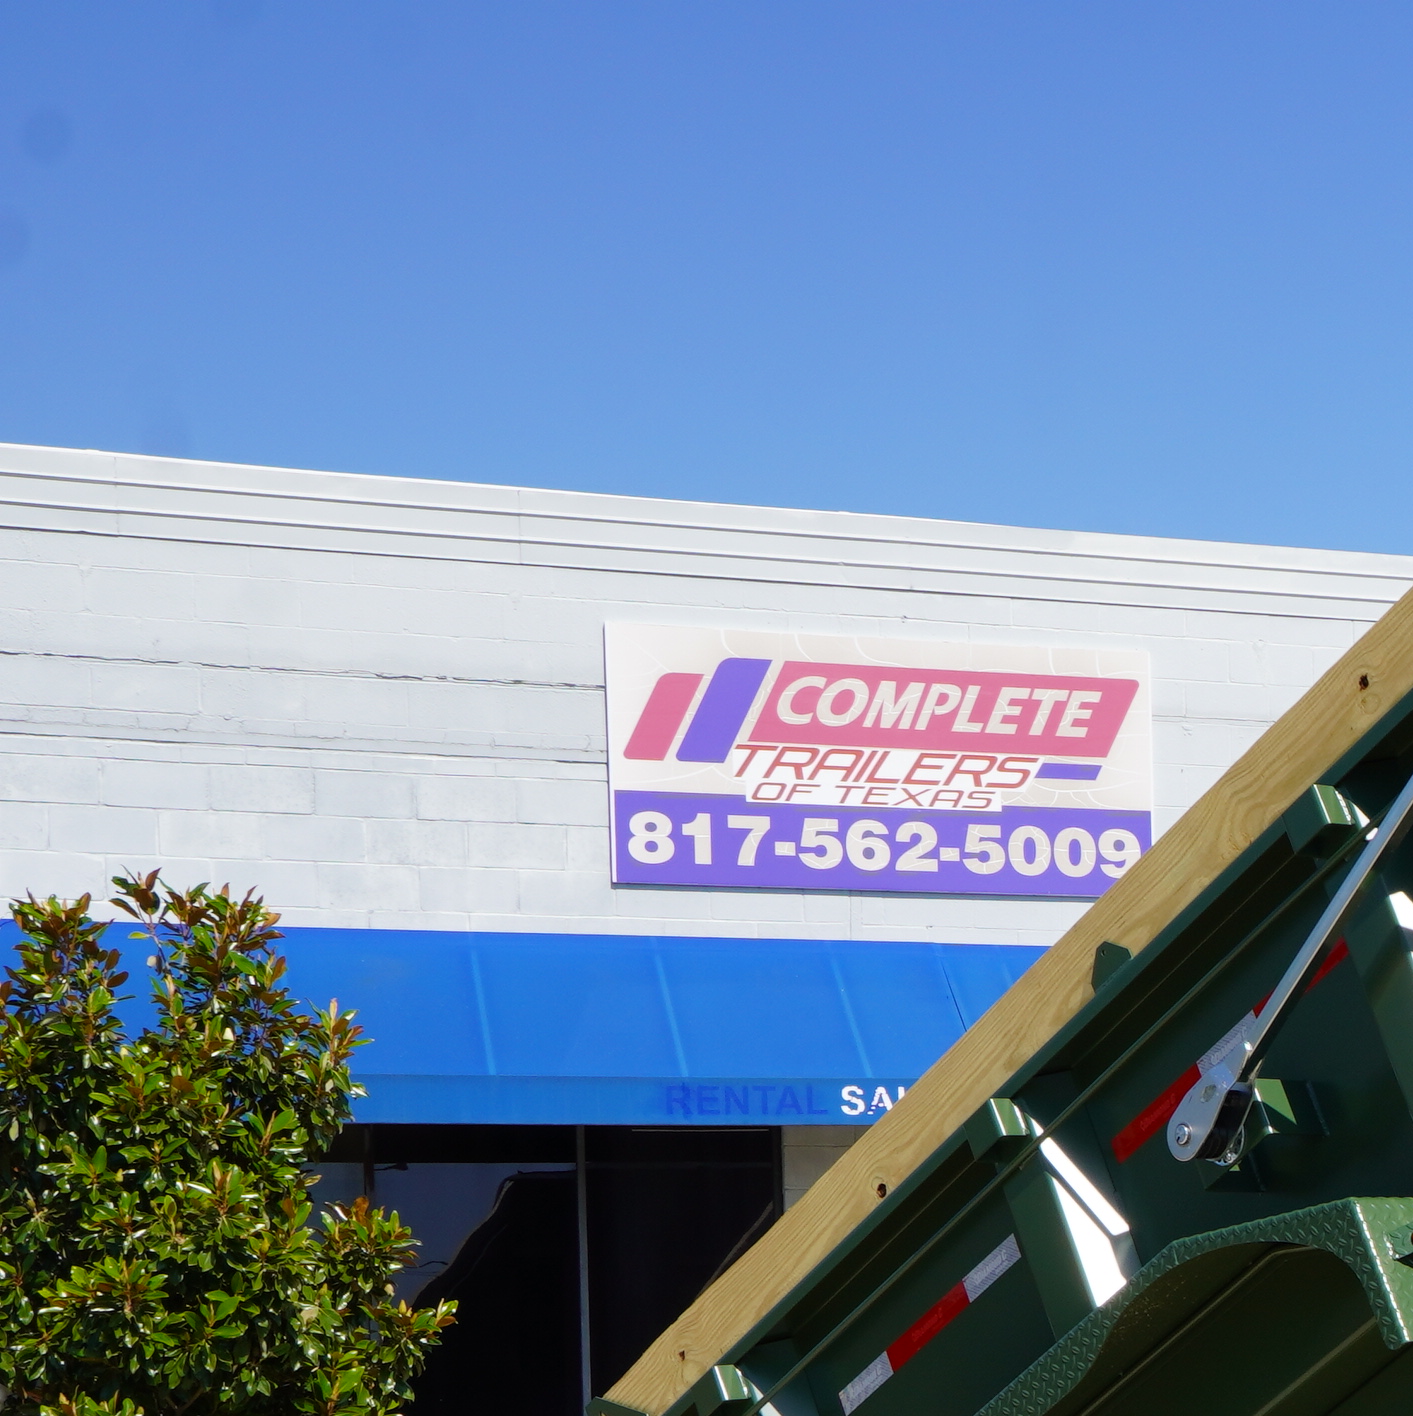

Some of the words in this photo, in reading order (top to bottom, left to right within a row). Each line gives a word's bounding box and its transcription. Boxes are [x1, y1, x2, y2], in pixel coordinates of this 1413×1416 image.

[776, 676, 1102, 738] COMPLETE
[733, 744, 1041, 789] TRAILERS
[751, 782, 821, 803] OF
[834, 785, 995, 810] TEXAS
[627, 810, 1142, 880] 817-562-5009
[665, 1084, 829, 1116] RENTAL
